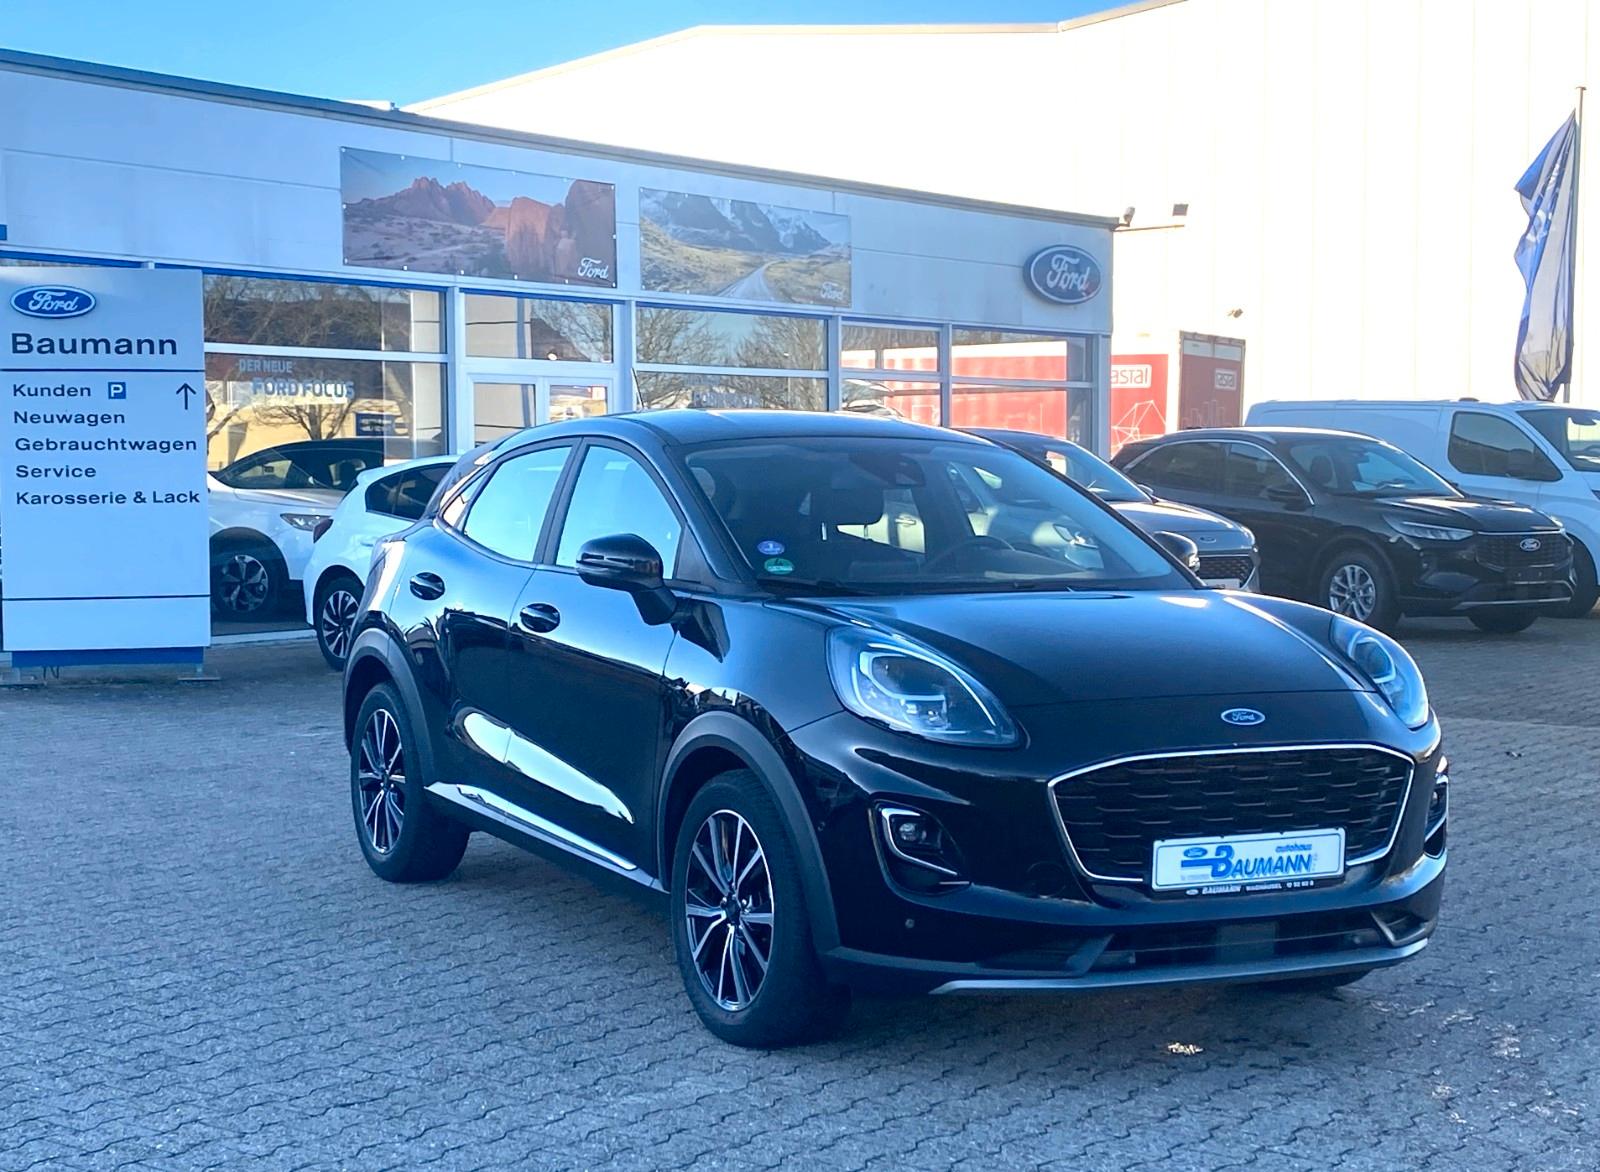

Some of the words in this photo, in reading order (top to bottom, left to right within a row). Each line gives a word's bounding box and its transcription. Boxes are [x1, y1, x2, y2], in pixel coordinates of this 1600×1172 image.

[577, 257, 609, 279] Ford
[1046, 254, 1090, 291] Ford
[28, 290, 79, 311] Ford
[11, 332, 178, 355] Baumann
[239, 359, 261, 373] DER
[263, 360, 293, 373] NEUE
[1111, 368, 1148, 385] astal
[13, 384, 91, 397] Kunden
[252, 377, 299, 396] FORD
[301, 379, 355, 400] FOCUS
[14, 411, 125, 427] Neuwagen
[15, 437, 197, 453] Gebrauchtwagen
[16, 464, 96, 478] Service
[16, 491, 127, 505] Karosserie
[133, 491, 147, 504] &
[153, 491, 200, 504] Lack
[1232, 711, 1256, 722] Ford
[1211, 845, 1312, 878] BAUMANN
